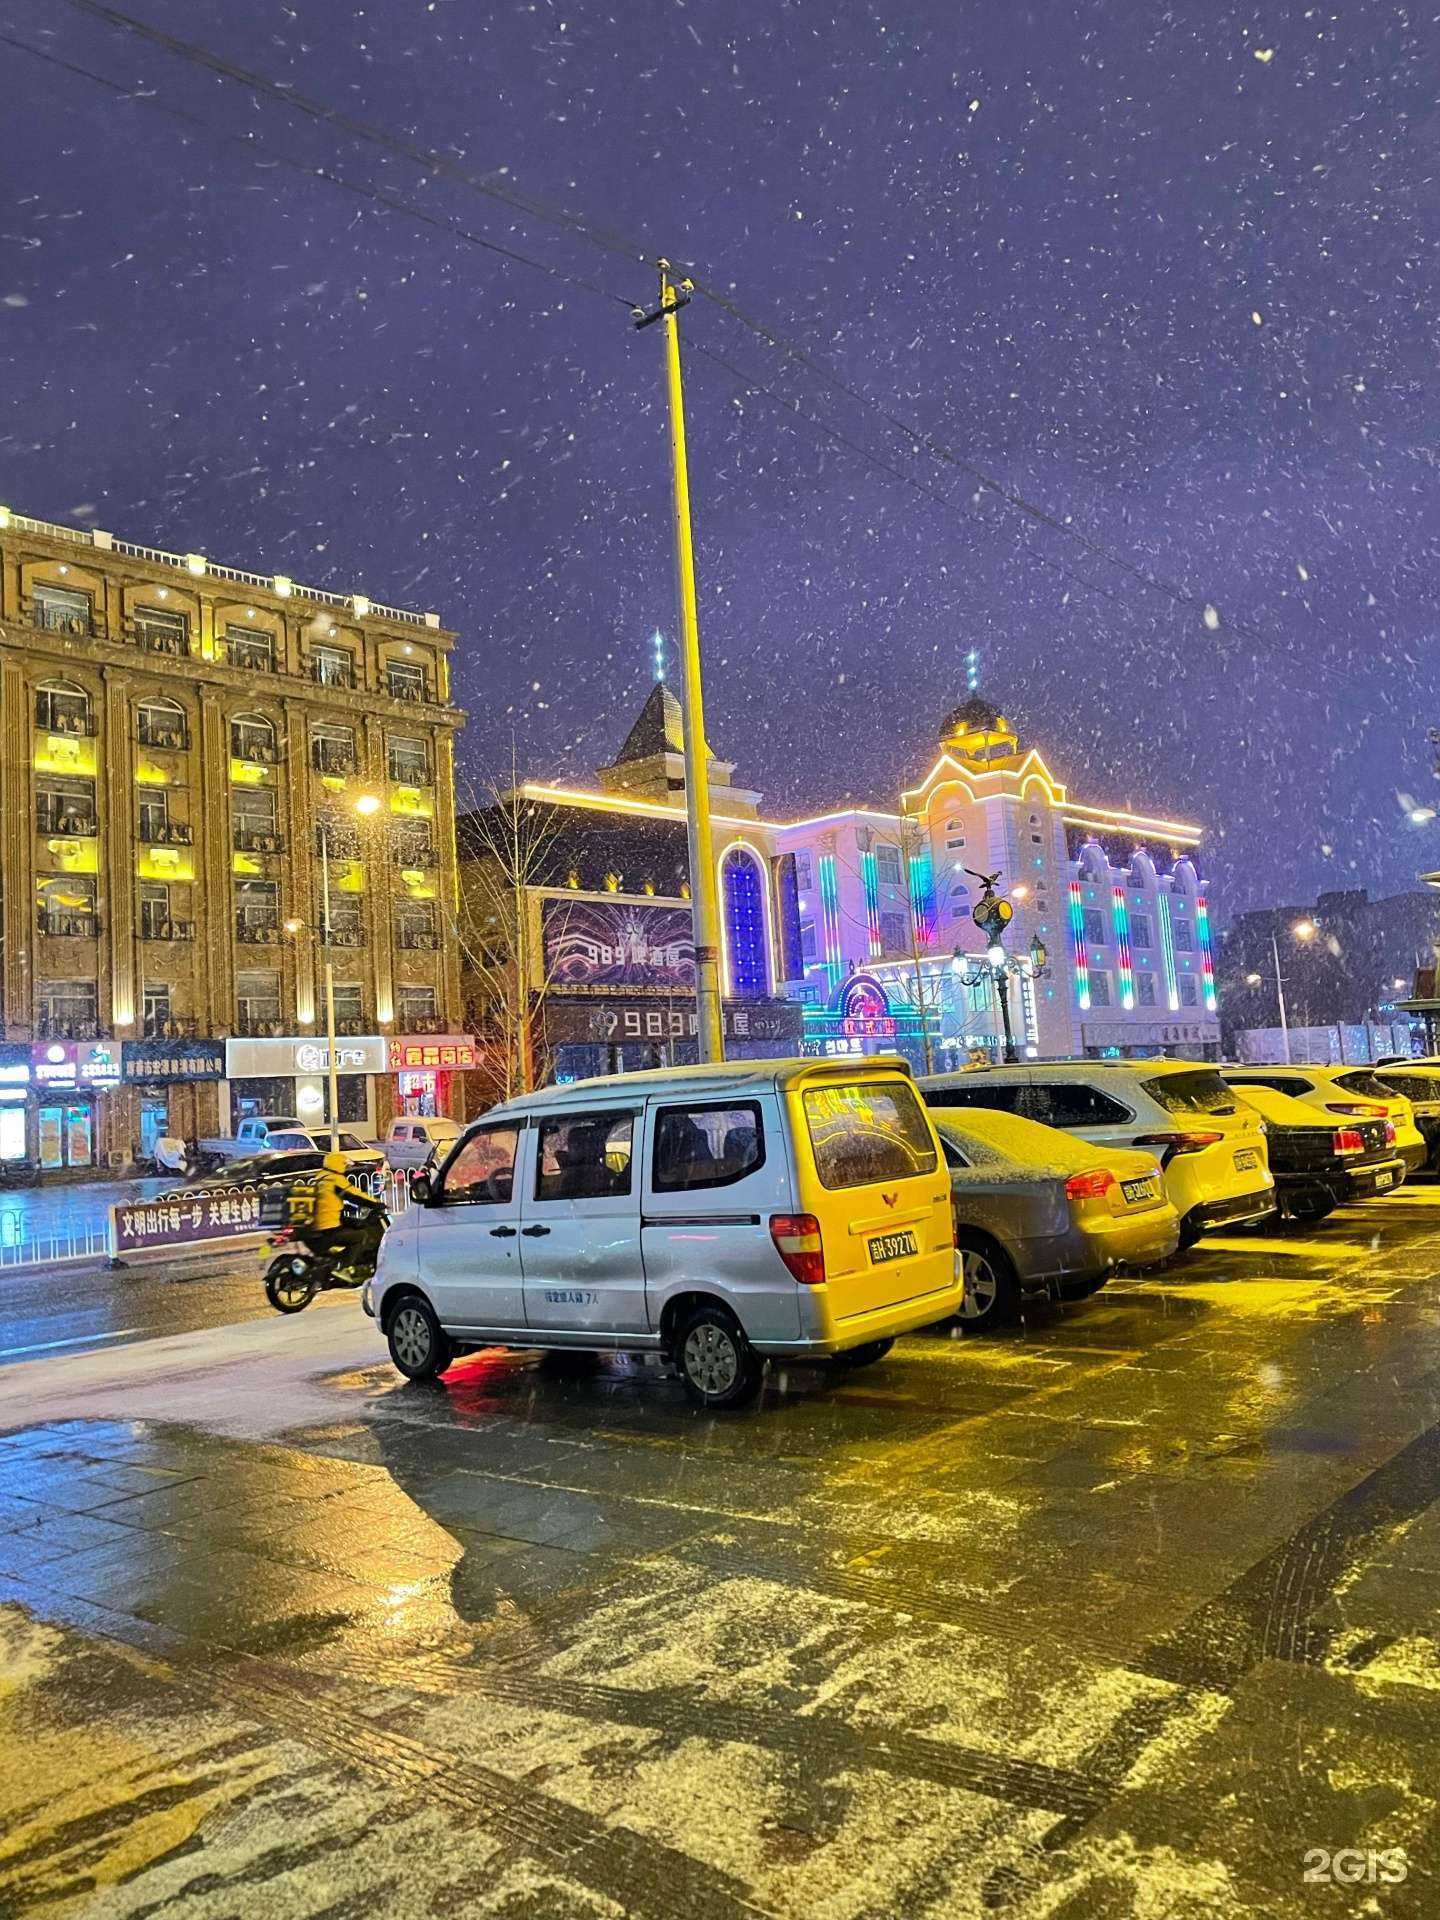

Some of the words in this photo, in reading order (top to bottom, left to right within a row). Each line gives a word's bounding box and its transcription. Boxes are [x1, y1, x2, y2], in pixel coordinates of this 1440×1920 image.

[122, 1204, 203, 1238] 文明出行每一步
